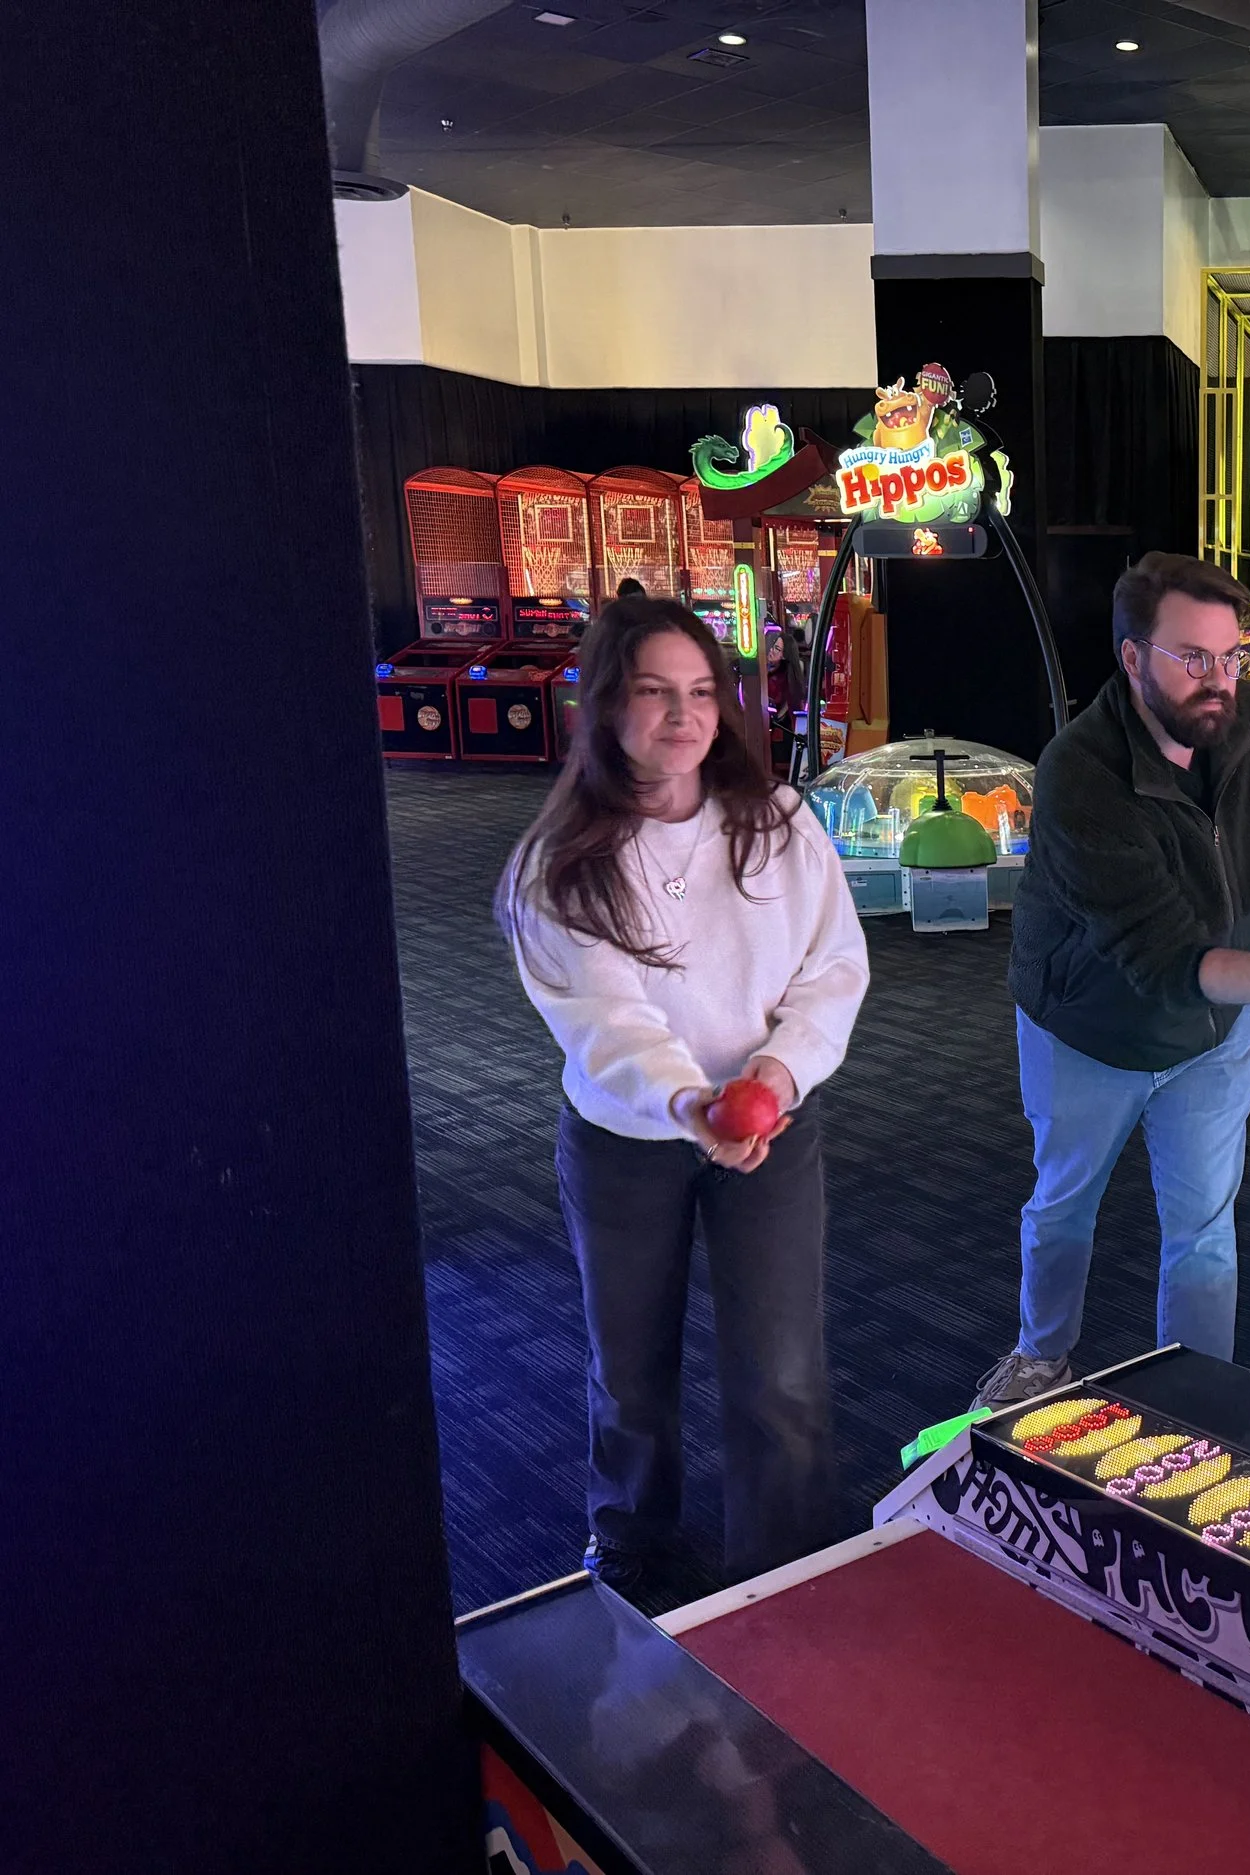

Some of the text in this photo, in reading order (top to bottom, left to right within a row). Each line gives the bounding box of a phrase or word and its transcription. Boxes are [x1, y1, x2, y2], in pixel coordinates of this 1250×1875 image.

[922, 371, 949, 383] GIGANTIC
[922, 377, 948, 395] FUN!
[844, 443, 931, 469] Hungry Hungry
[841, 455, 967, 513] Hippos
